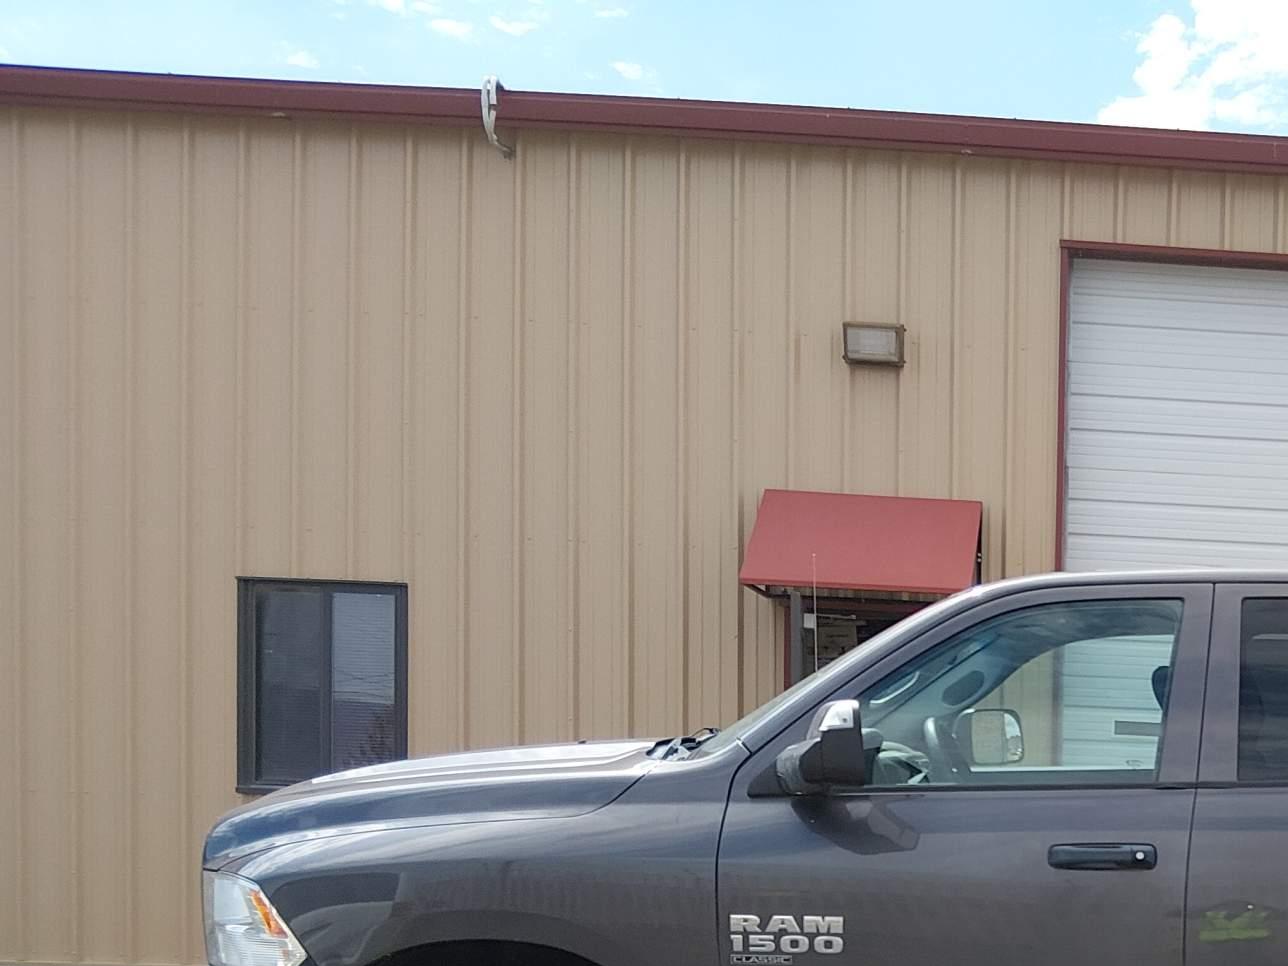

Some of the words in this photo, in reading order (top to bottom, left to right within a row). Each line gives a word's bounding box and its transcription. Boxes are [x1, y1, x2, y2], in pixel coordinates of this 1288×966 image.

[729, 914, 844, 934] RAM
[730, 934, 844, 954] 1500
[731, 954, 793, 966] CLASSIC
